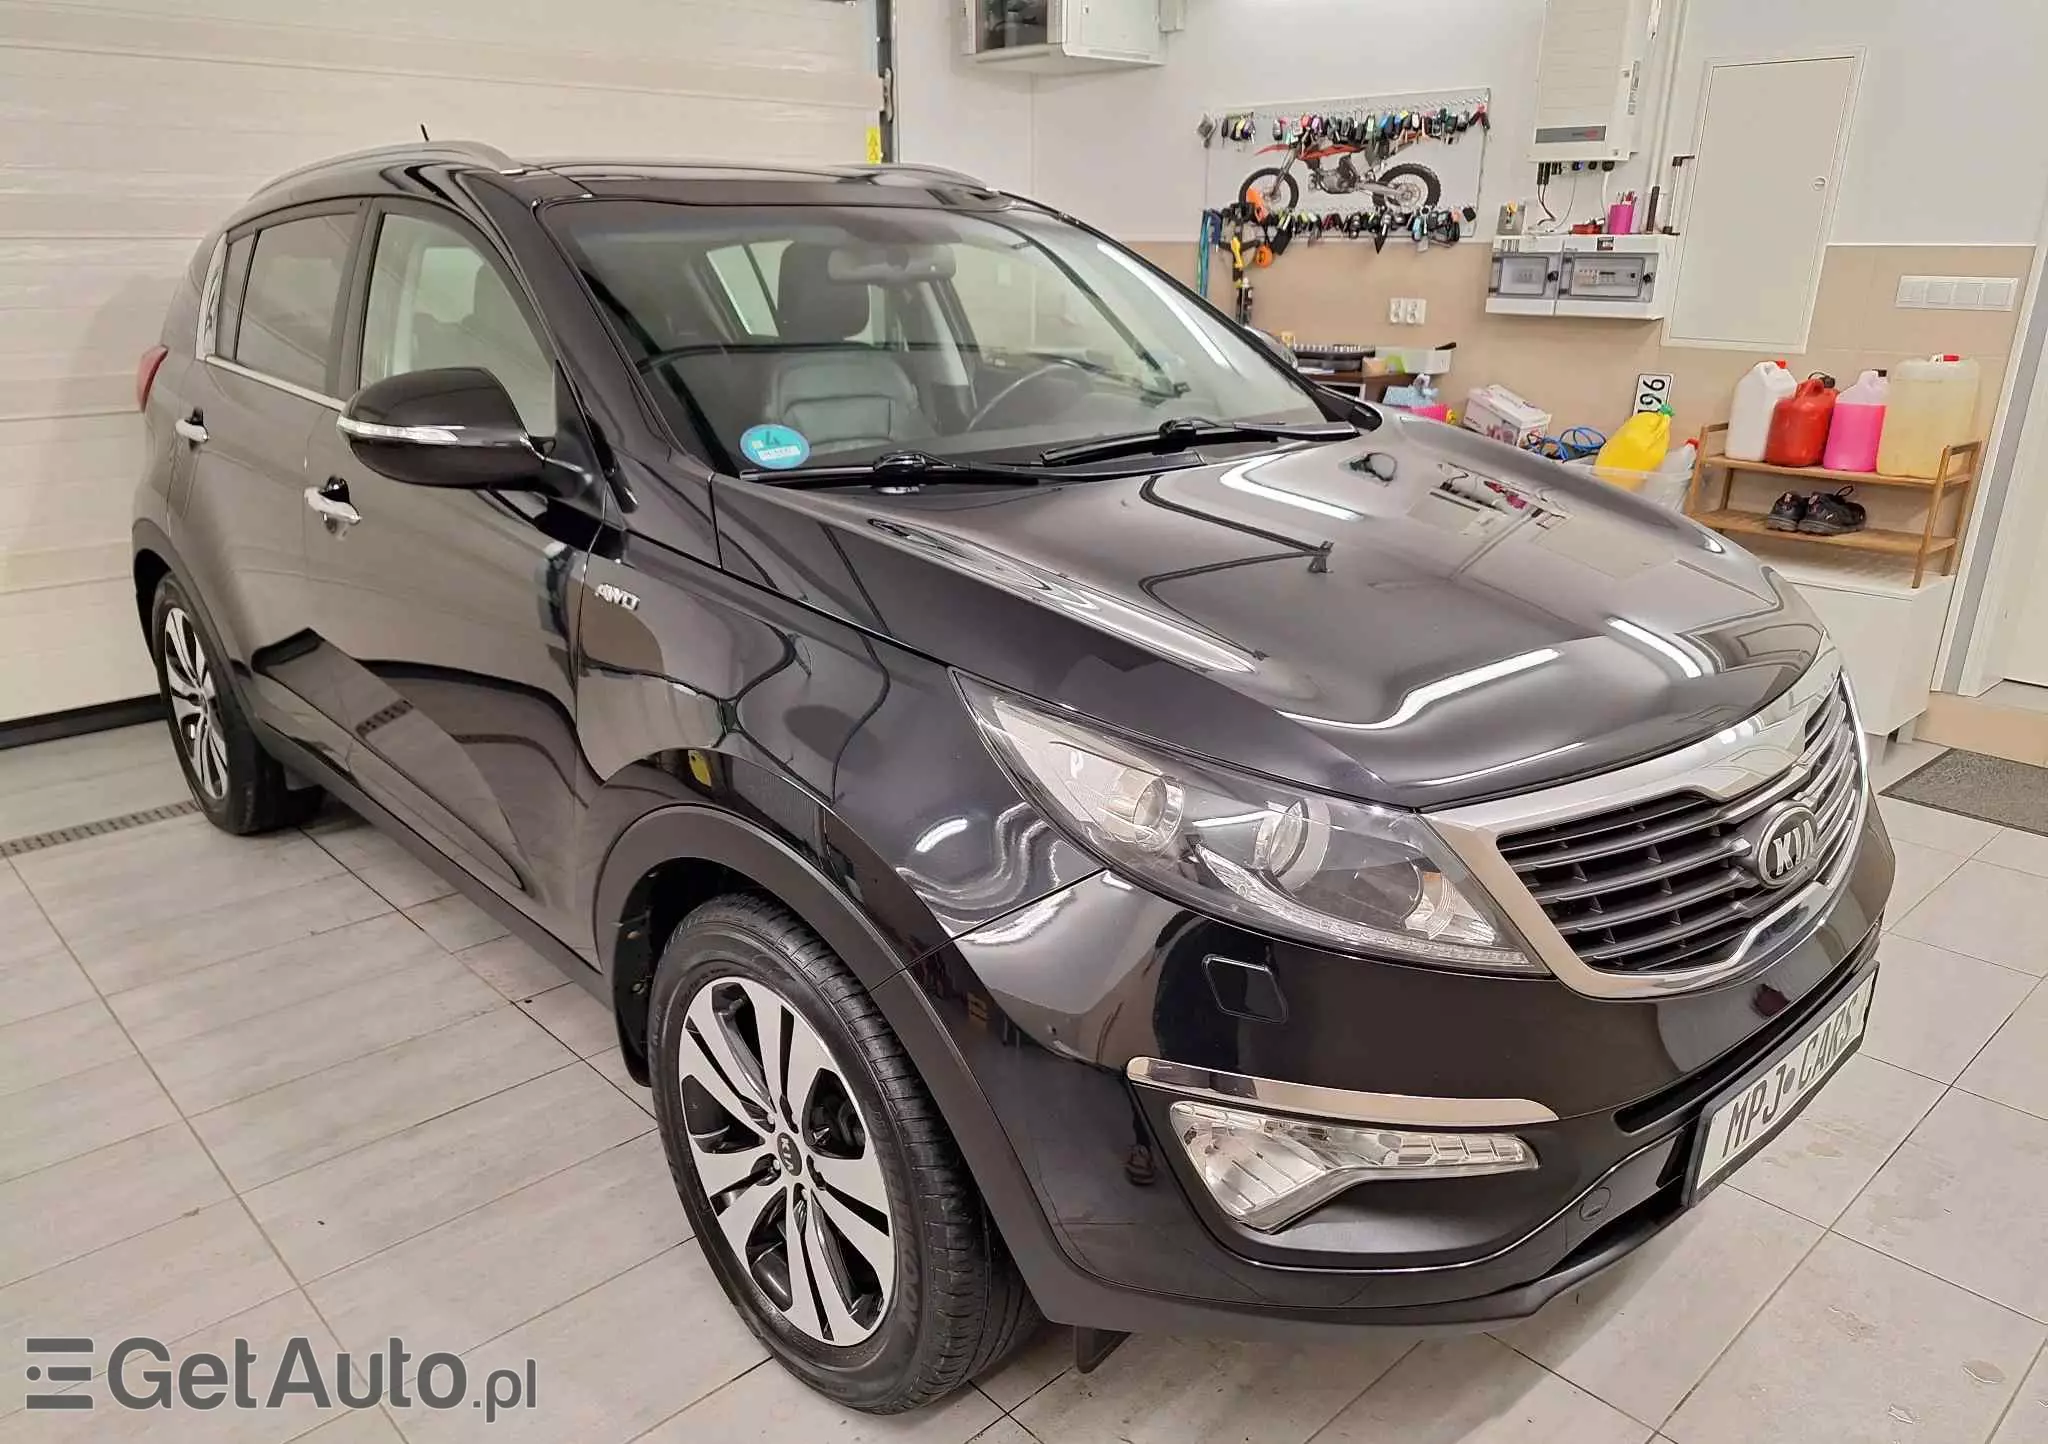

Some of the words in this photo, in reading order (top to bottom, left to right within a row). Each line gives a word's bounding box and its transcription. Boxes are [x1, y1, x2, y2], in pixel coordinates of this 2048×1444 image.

[594, 583, 641, 611] AWD
[1773, 819, 1815, 876] KIA
[1722, 1063, 1787, 1158] MPJ
[1798, 992, 1858, 1089] CARS
[780, 1137, 795, 1172] KIA
